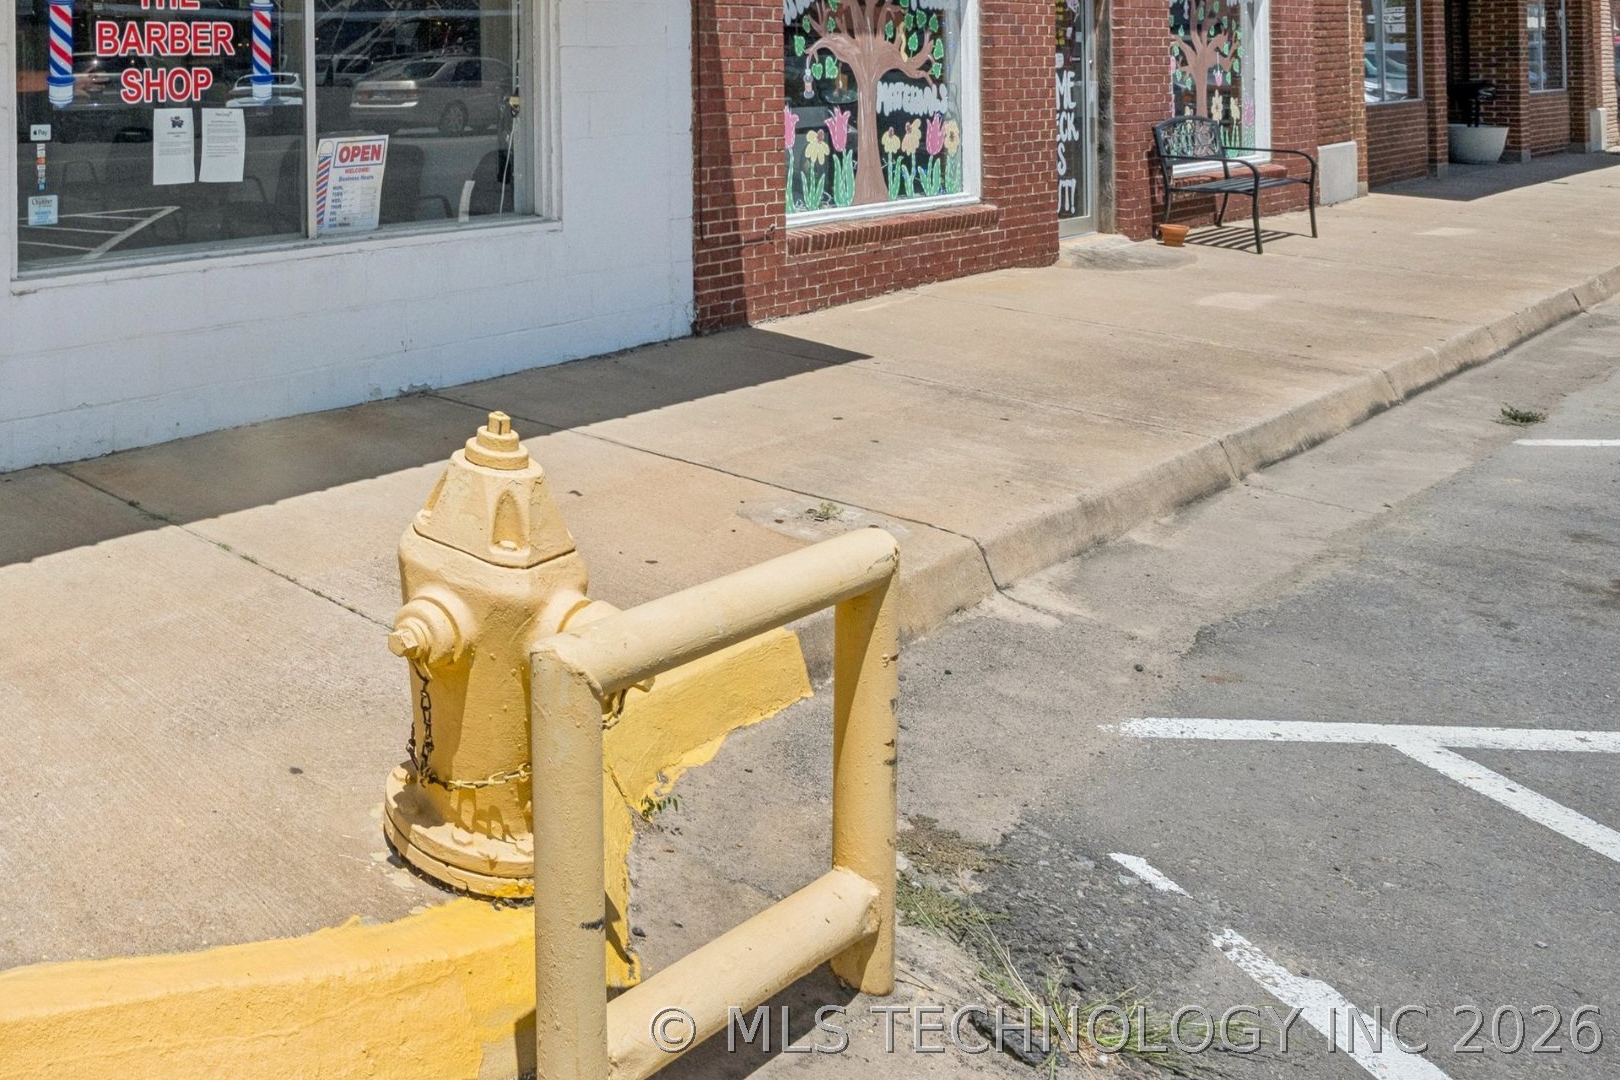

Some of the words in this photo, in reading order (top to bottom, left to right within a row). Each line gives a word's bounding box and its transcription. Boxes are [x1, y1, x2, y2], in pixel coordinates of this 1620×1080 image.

[95, 20, 235, 56] BARBER
[120, 67, 213, 104] SHOP
[338, 144, 382, 164] OPEN
